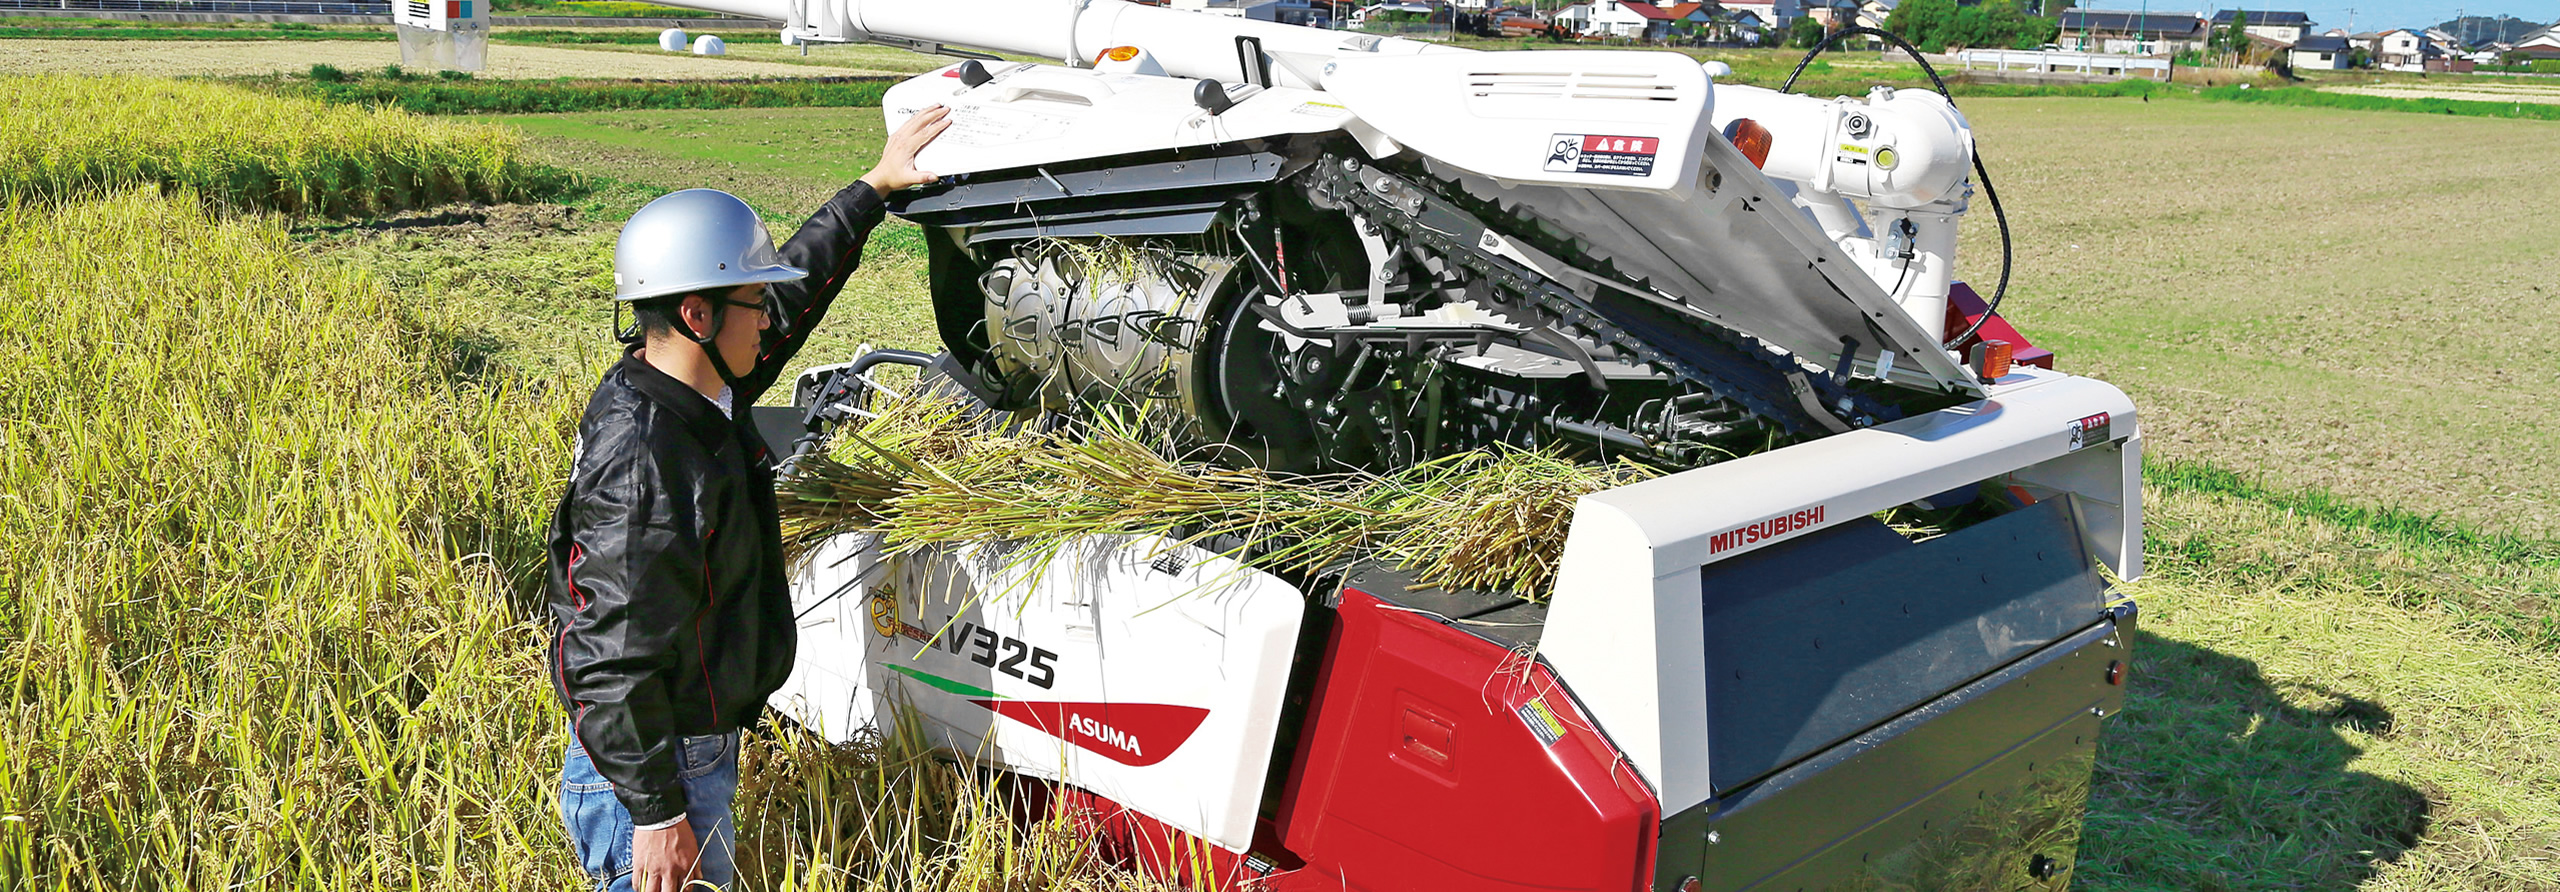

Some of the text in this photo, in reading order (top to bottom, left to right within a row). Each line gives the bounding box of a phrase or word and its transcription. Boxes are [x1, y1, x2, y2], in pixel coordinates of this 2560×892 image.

[1709, 505, 1825, 555] MITSUBISHI
[946, 614, 1059, 690] V325
[1068, 712, 1143, 757] ASUMA
